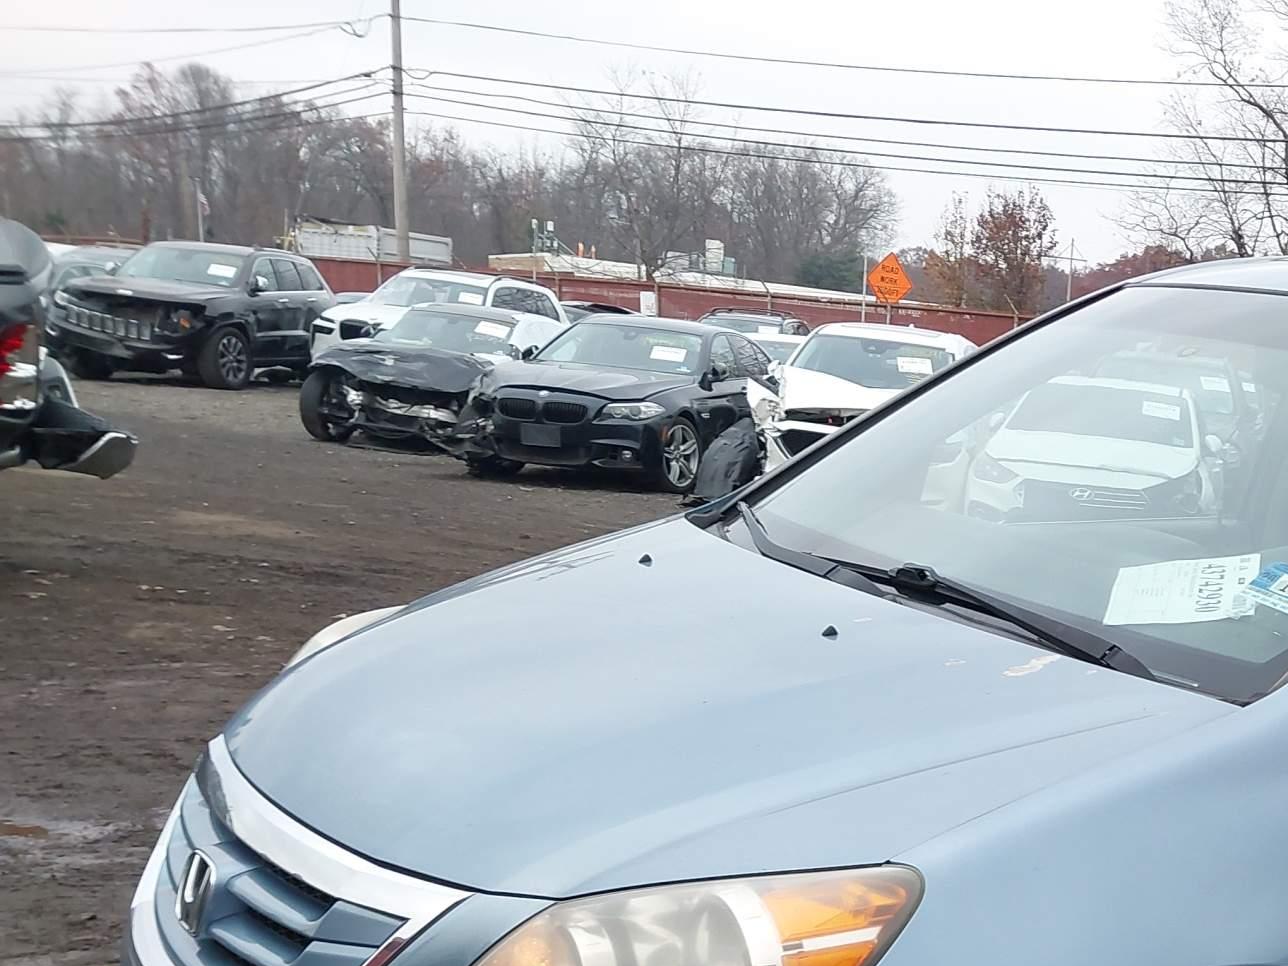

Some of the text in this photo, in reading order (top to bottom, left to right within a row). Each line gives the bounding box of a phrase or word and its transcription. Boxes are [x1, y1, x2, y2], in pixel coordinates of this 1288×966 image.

[881, 264, 899, 274] ROAD
[880, 276, 898, 285] WORK
[1195, 563, 1226, 614] 43742930
